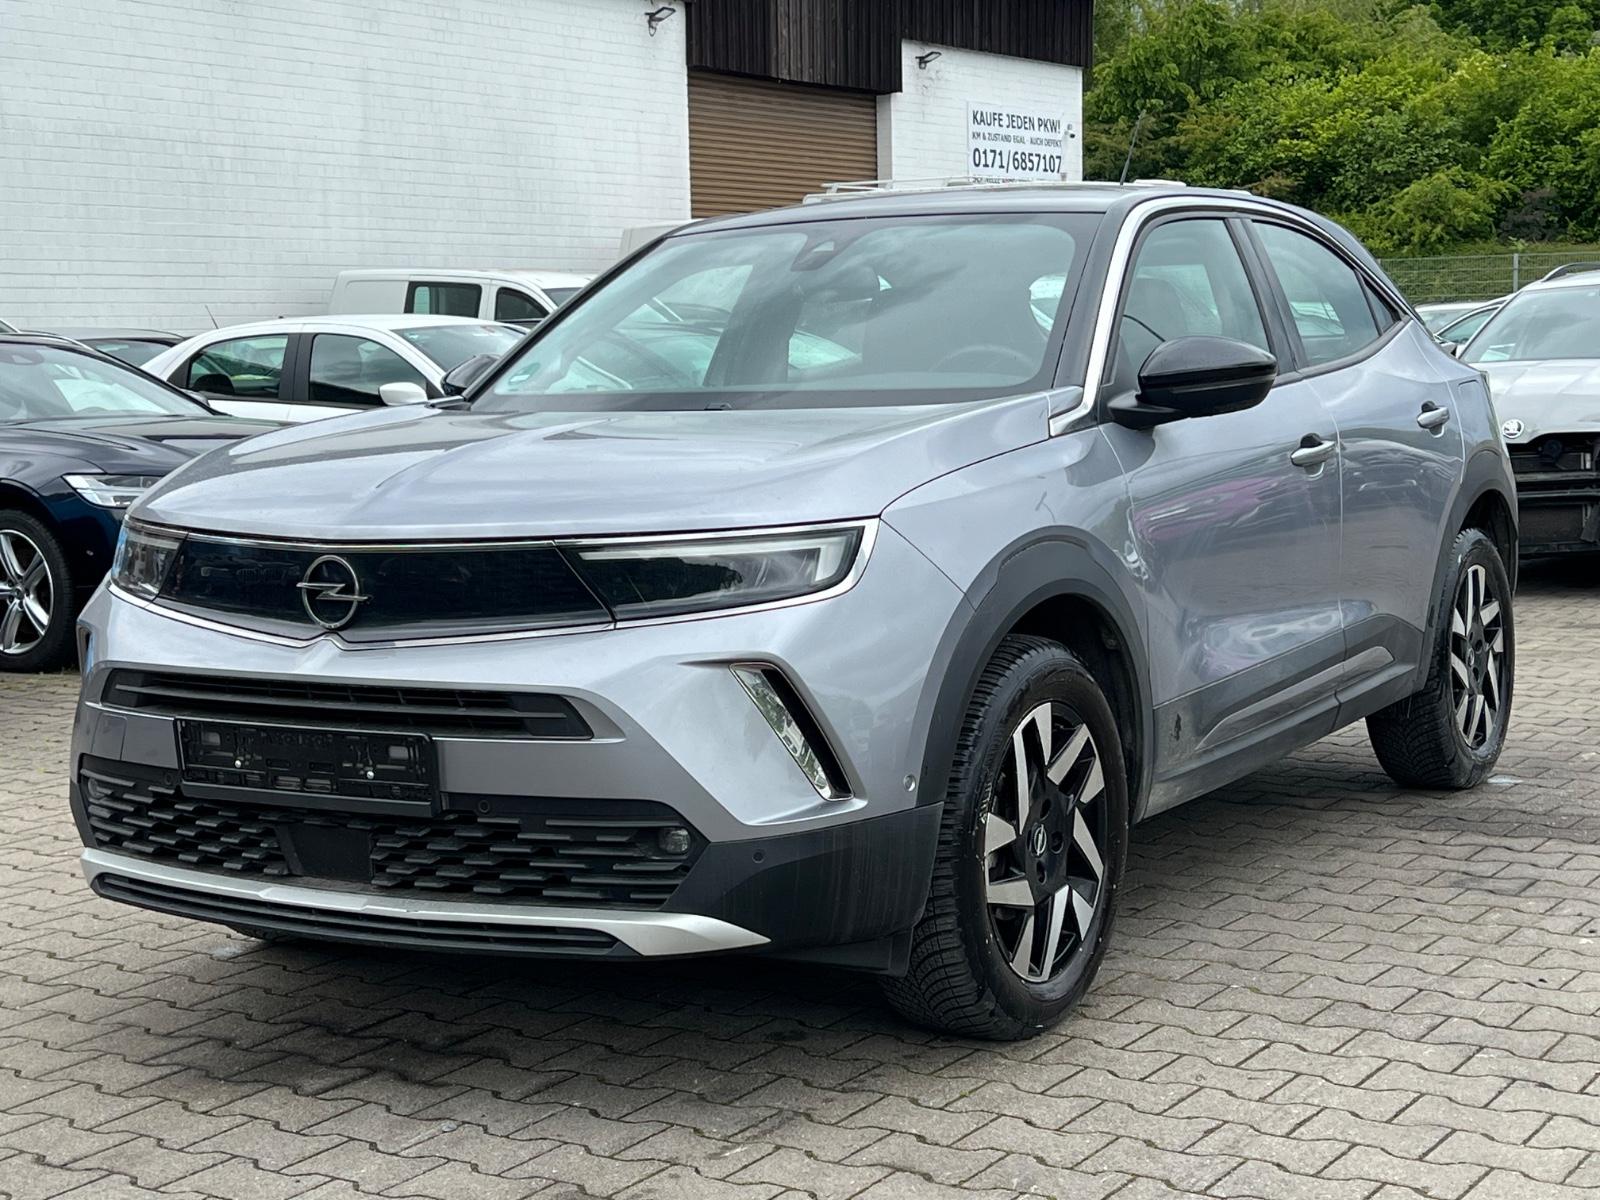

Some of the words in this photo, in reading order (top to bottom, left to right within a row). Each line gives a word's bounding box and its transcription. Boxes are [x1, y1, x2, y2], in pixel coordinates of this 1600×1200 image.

[972, 110, 1004, 128] KAUFE
[1006, 114, 1035, 131] JEDEN
[1038, 117, 1061, 134] PKW!
[972, 132, 981, 140] KM
[988, 133, 1012, 143] ZUSTAND
[1013, 135, 1026, 144] EGAL
[1030, 137, 1043, 146] AUCH
[973, 147, 1062, 174] 0171/6857107
